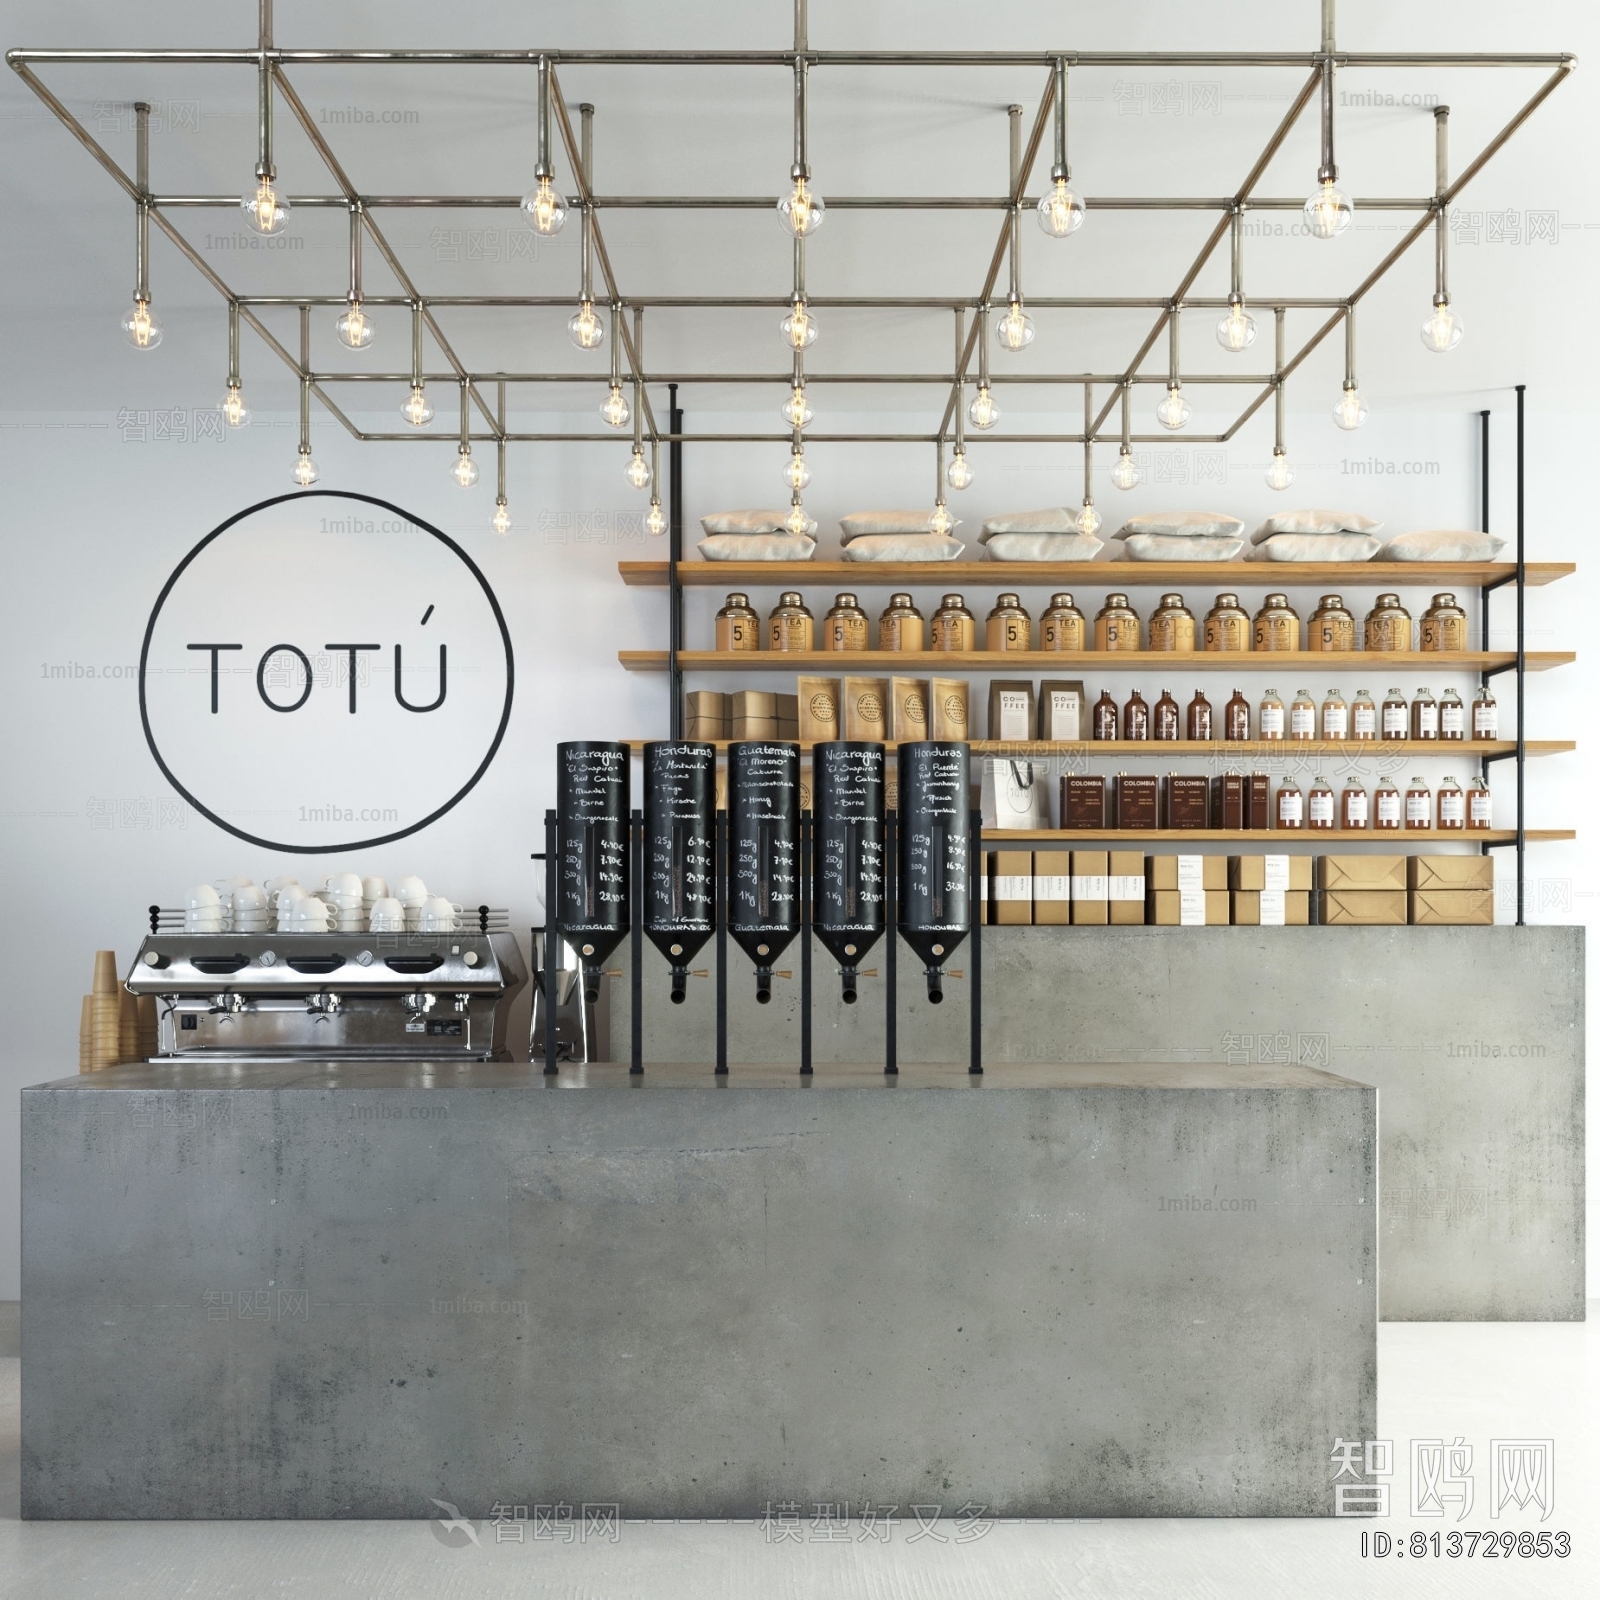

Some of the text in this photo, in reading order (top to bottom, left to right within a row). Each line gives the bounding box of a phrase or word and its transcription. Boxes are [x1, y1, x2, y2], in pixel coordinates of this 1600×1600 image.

[847, 619, 864, 628] TEA
[941, 620, 959, 628] TEA
[1059, 619, 1076, 627] TEA
[1122, 620, 1137, 628] TEA
[1218, 620, 1236, 628] TEA
[1268, 620, 1286, 628] TEA
[1338, 621, 1352, 629] TEA
[733, 625, 743, 641] 5
[773, 625, 780, 641] 5
[834, 625, 843, 642] 5
[1008, 626, 1017, 642] 5
[1046, 626, 1055, 642] 5
[1108, 626, 1118, 642] 5
[1207, 627, 1214, 644] 5
[1256, 628, 1264, 644] 5
[1323, 627, 1333, 643] 5
[1424, 627, 1433, 644] 5
[186, 603, 448, 715] TOTÚ
[565, 749, 624, 767] Nicaragua
[654, 744, 713, 758] Honduras
[738, 745, 796, 758] Guatemala
[826, 749, 884, 767] Nicaragua
[914, 746, 962, 758] Honduras
[573, 774, 588, 783] Red
[833, 774, 848, 783] Red
[579, 798, 605, 807] Birne
[749, 796, 772, 808] Honig
[839, 798, 865, 807] Birne
[566, 839, 583, 853] 125g
[654, 836, 672, 850] 125g
[740, 839, 757, 853] 125g
[827, 839, 844, 853] 125g
[912, 835, 930, 846] 125g
[738, 854, 757, 869] 250g
[737, 869, 758, 885] 500g
[734, 924, 790, 932] Guatemala
